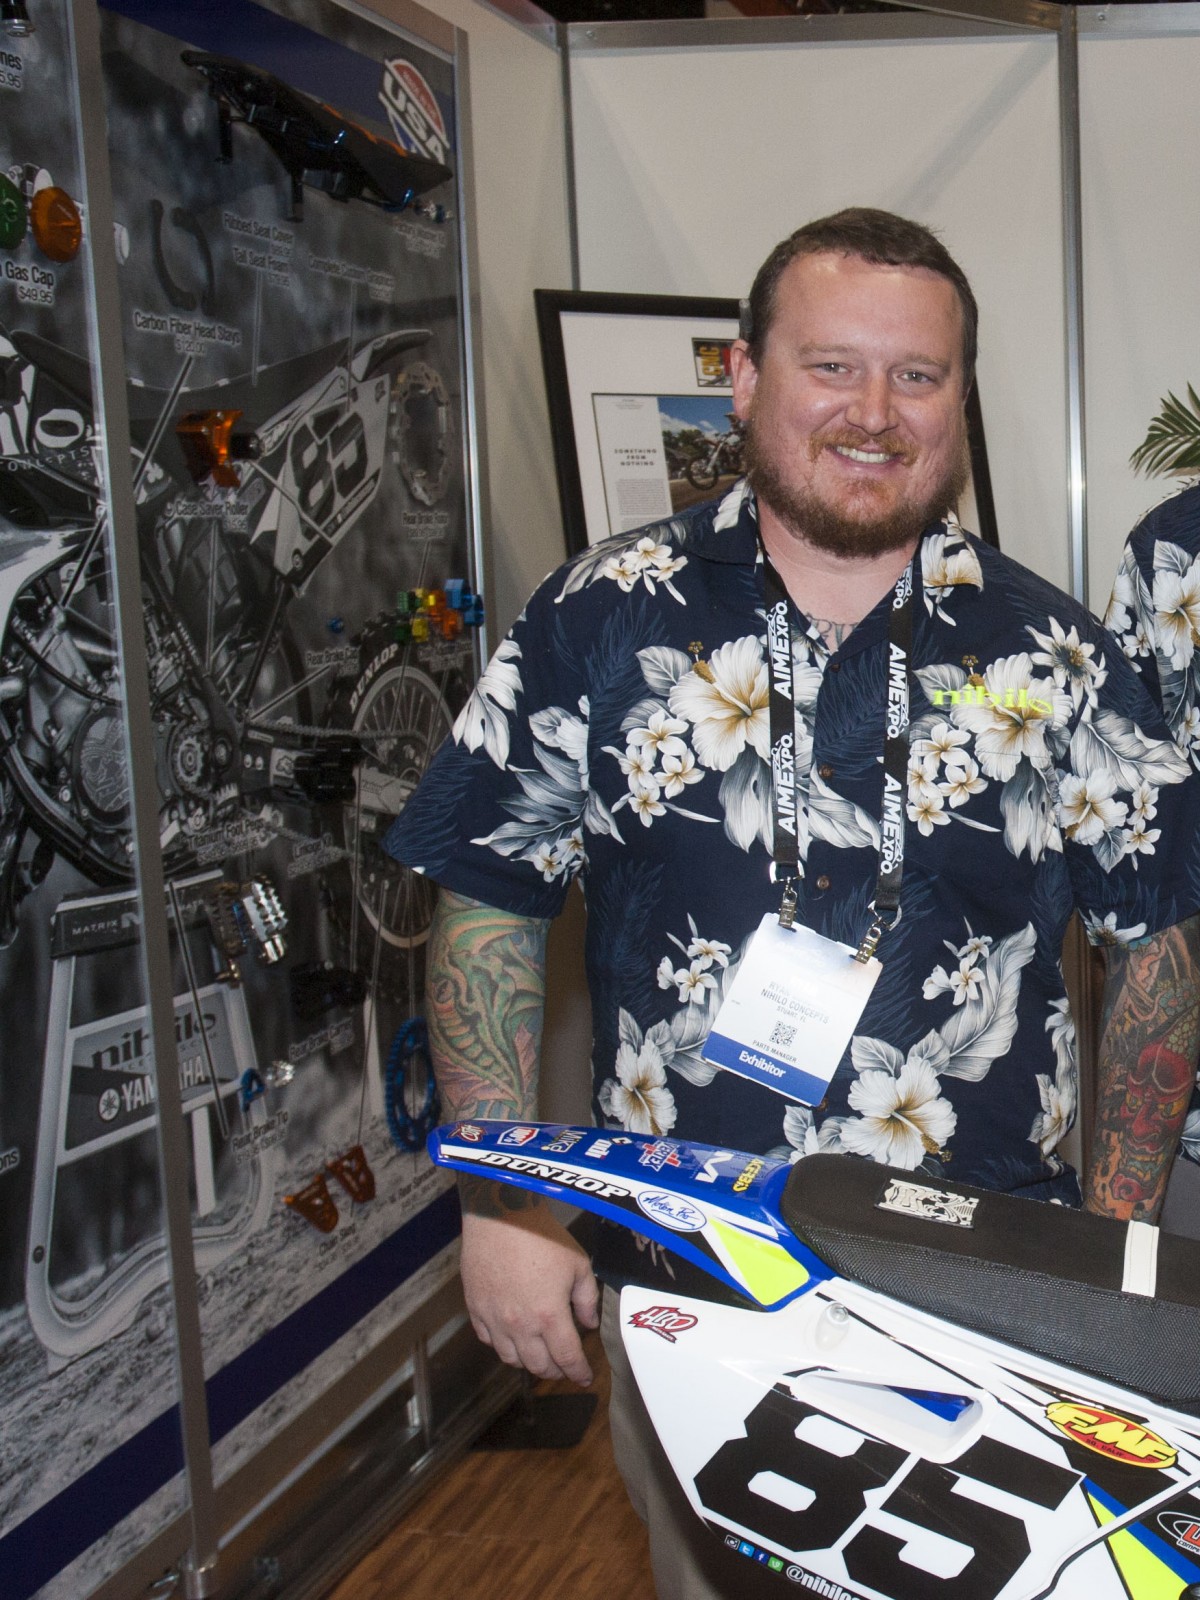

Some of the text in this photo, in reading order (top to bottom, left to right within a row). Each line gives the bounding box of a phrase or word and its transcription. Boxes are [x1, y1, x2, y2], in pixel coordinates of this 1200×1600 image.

[383, 71, 446, 165] USA
[6, 261, 54, 289] Gas Cap
[19, 286, 53, 304] $49.95
[134, 311, 241, 344] Carbon Fiber Head Stays
[350, 643, 399, 714] DUNLOP
[932, 683, 1055, 715] nihilo
[72, 919, 120, 937] MATRIX
[761, 989, 830, 1024] NIHILO CONCEPTS
[739, 1050, 786, 1078] Exhibitor
[752, 1040, 797, 1063] PARTS MANAGER
[479, 1153, 631, 1198] DUNLOP
[642, 1194, 699, 1220] Motion Pro
[1044, 1404, 1180, 1462] FMF
[693, 1366, 1082, 1600] 85
